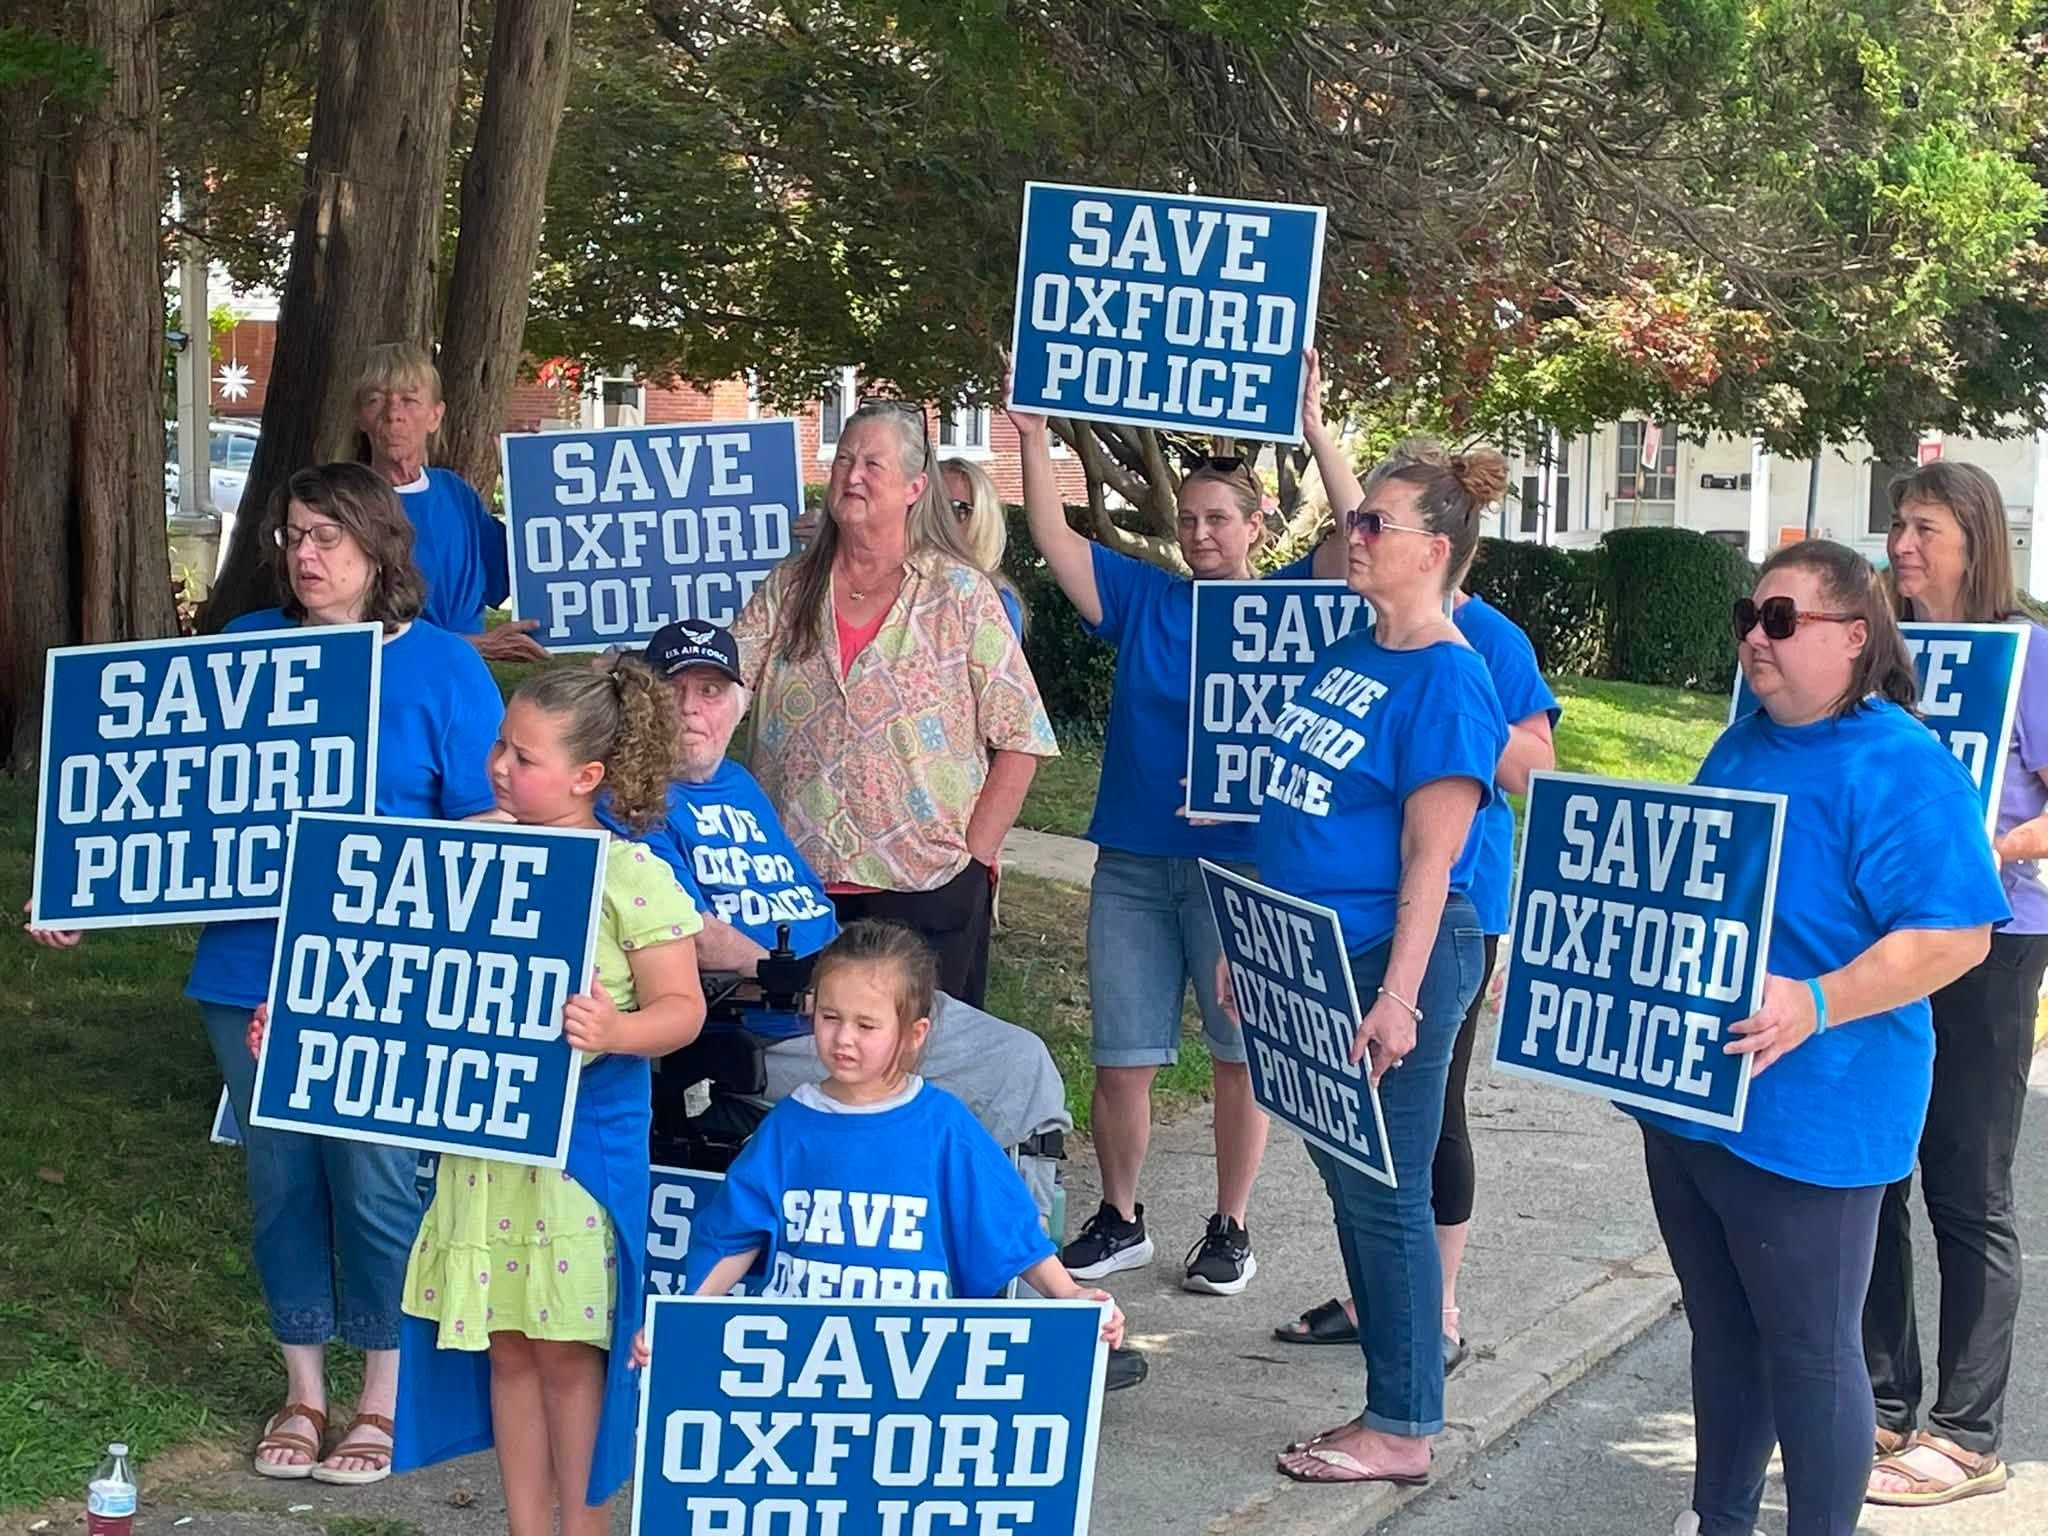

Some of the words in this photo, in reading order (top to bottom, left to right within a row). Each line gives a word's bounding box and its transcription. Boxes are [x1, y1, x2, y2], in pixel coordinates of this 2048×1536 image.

[1069, 200, 1270, 282] SAVE
[1031, 273, 1296, 356] OXFORD
[1041, 342, 1271, 423] POLICE
[552, 431, 754, 505] SAVE
[525, 502, 792, 574] OXFORD
[98, 646, 320, 740] SAVE
[681, 646, 700, 655] AIR
[701, 647, 729, 665] FORCE
[1311, 666, 1389, 719] SAVE
[1272, 702, 1366, 770] XFORD
[58, 736, 355, 825] OXFORD
[1266, 752, 1333, 816] LICE
[71, 824, 292, 906] POLIC
[332, 833, 548, 940] SAVE
[1558, 794, 1734, 902] SAVE
[1223, 886, 1328, 993] SAVE
[1520, 890, 1750, 1003] OXFORD
[286, 934, 571, 1042] OXFORD
[1231, 961, 1361, 1080] OXFORD
[1520, 980, 1722, 1098] POLICE
[288, 1030, 539, 1140] POLICE
[1254, 1037, 1370, 1156] POLICE
[783, 1188, 928, 1250] SAVE
[719, 1315, 1031, 1400] SAVE
[662, 1410, 1071, 1488] OXFORD
